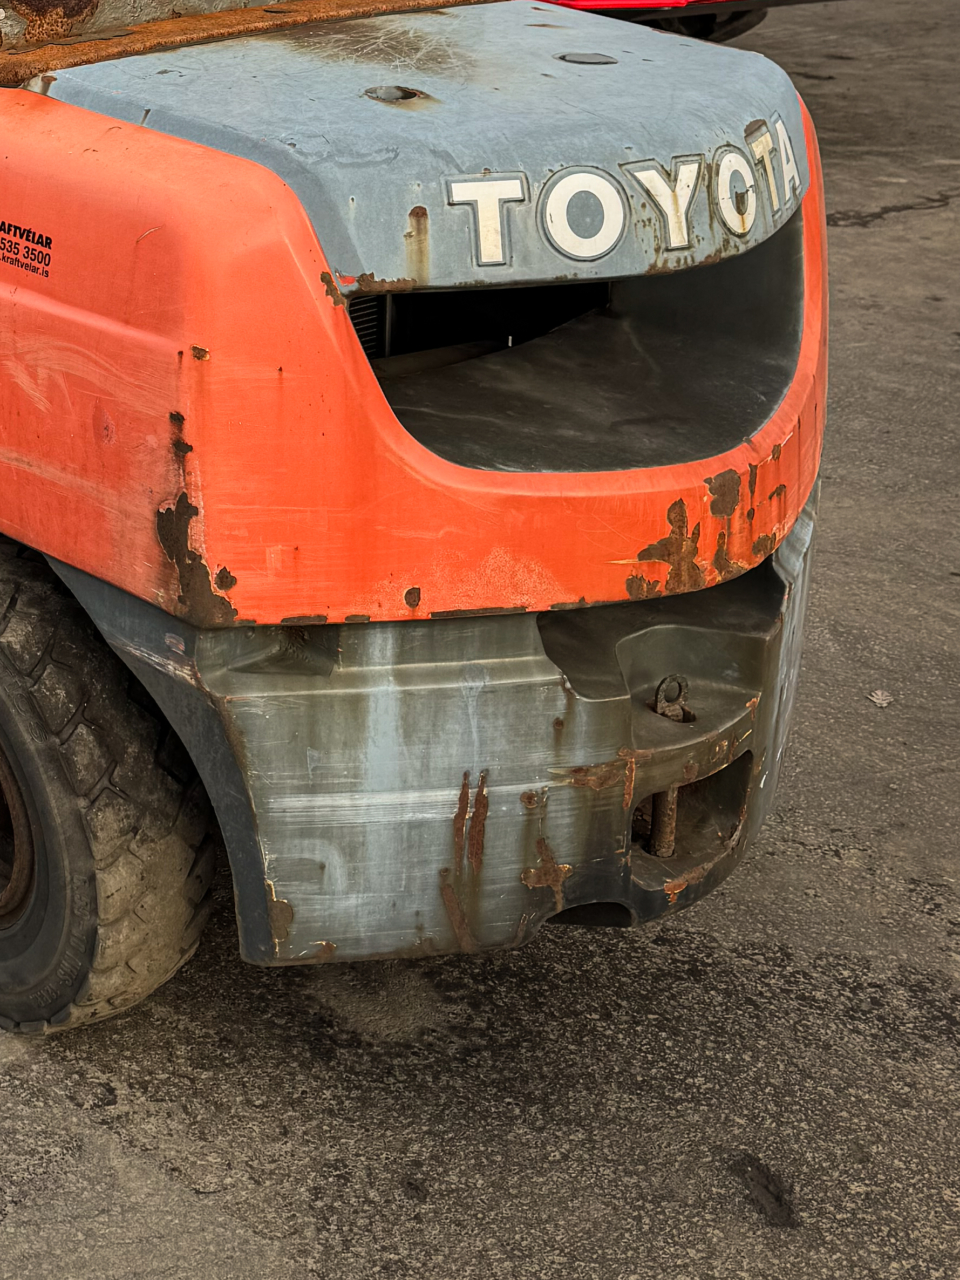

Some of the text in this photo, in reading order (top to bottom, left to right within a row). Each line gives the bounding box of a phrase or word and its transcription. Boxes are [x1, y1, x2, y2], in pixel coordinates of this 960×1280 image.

[448, 113, 806, 266] TOYOTA
[0, 237, 52, 267] 535 3500
